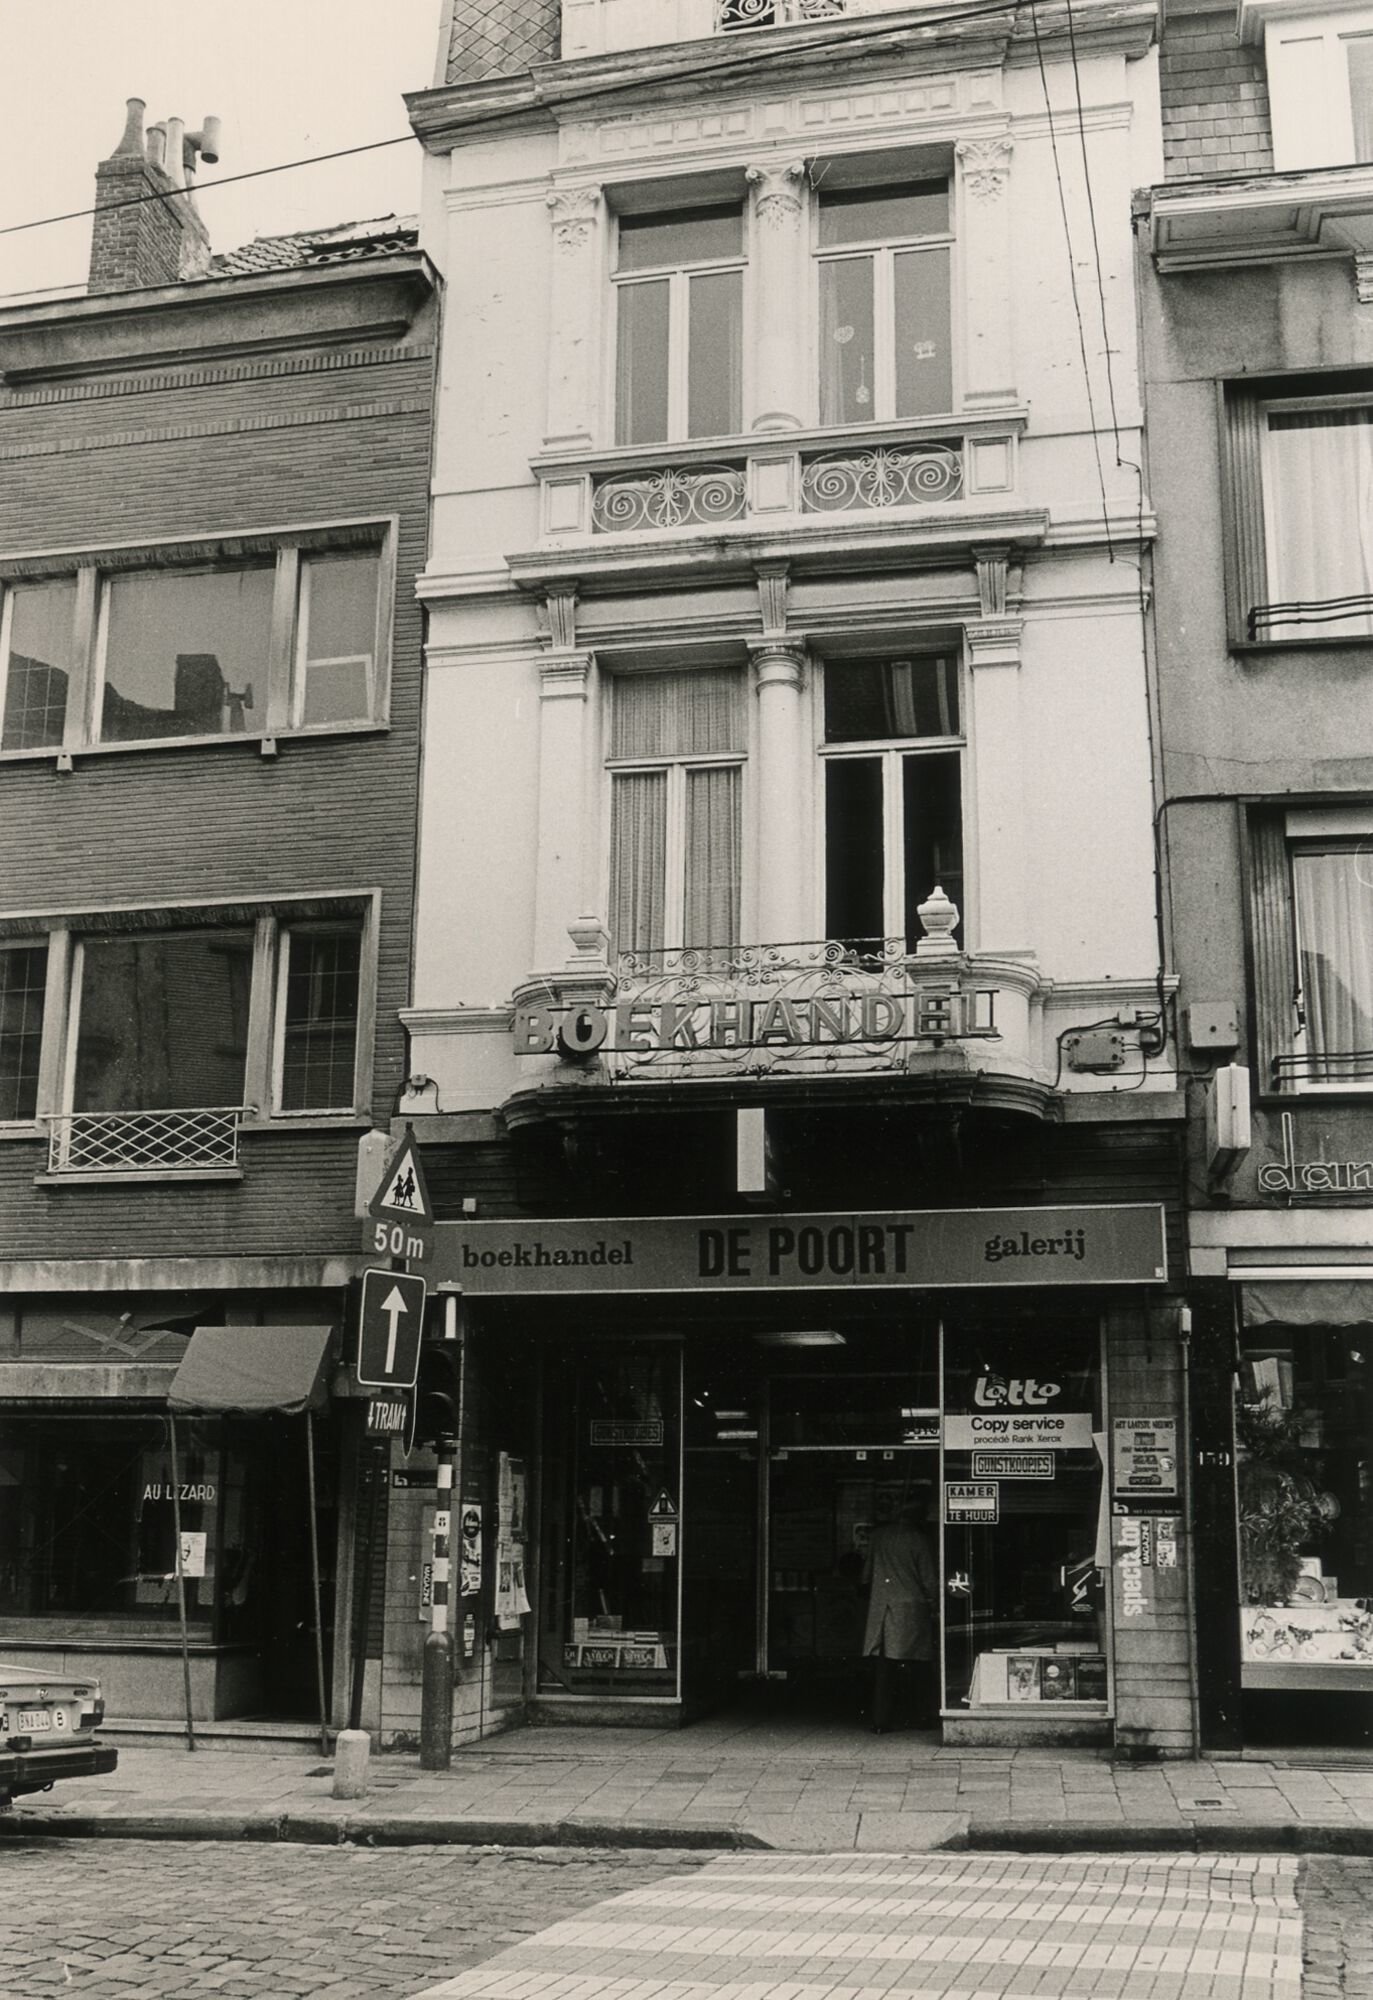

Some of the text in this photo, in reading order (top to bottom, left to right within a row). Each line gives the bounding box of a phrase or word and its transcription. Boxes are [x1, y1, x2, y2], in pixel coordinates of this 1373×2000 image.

[514, 990, 998, 1054] BOEKHANDEL
[462, 1240, 633, 1268] boekhandel
[699, 1224, 914, 1277] DE POORT
[984, 1229, 1085, 1262] galerij
[973, 1377, 1061, 1407] Lotto
[375, 1402, 402, 1430] TRAM
[971, 1416, 1065, 1433] Copy service
[1012, 1434, 1034, 1444] Rank
[1036, 1433, 1062, 1443] Xerox
[978, 1456, 1050, 1473] GUNSTKOOPJES
[143, 1484, 215, 1501] AU LZARD
[950, 1486, 994, 1497] KAMER
[949, 1510, 995, 1521] TE HUUR
[1141, 1522, 1150, 1565] MAGAZINE
